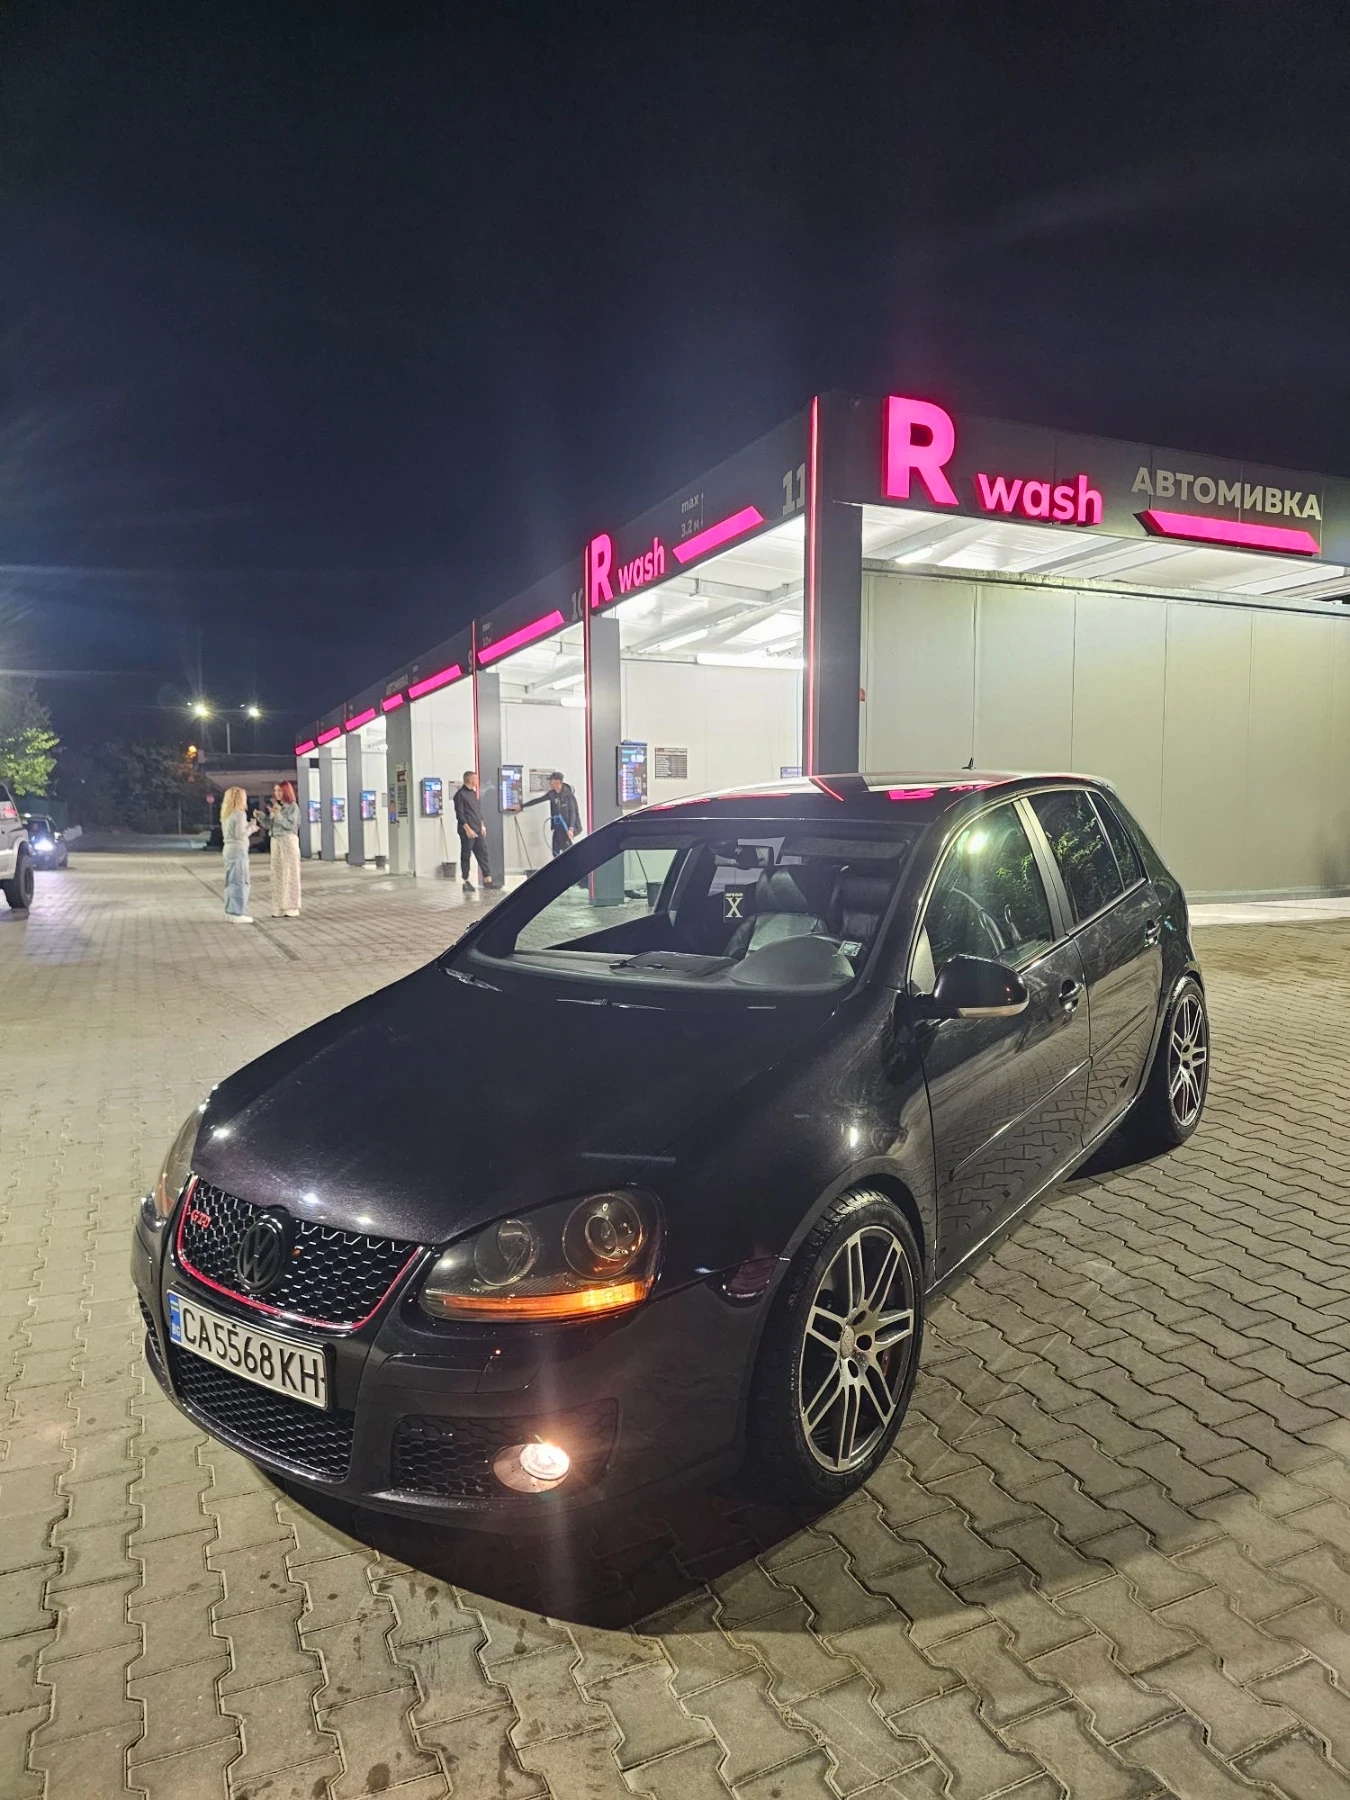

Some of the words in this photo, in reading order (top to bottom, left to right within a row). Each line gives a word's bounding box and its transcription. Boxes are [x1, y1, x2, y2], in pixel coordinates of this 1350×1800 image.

[886, 395, 959, 505] R
[977, 472, 1103, 524] wash
[681, 494, 699, 514] max
[1131, 466, 1323, 521] АВТОМИВКА
[591, 533, 614, 608] R
[618, 536, 665, 593] wash
[725, 897, 744, 918] X
[172, 1322, 181, 1337] BG
